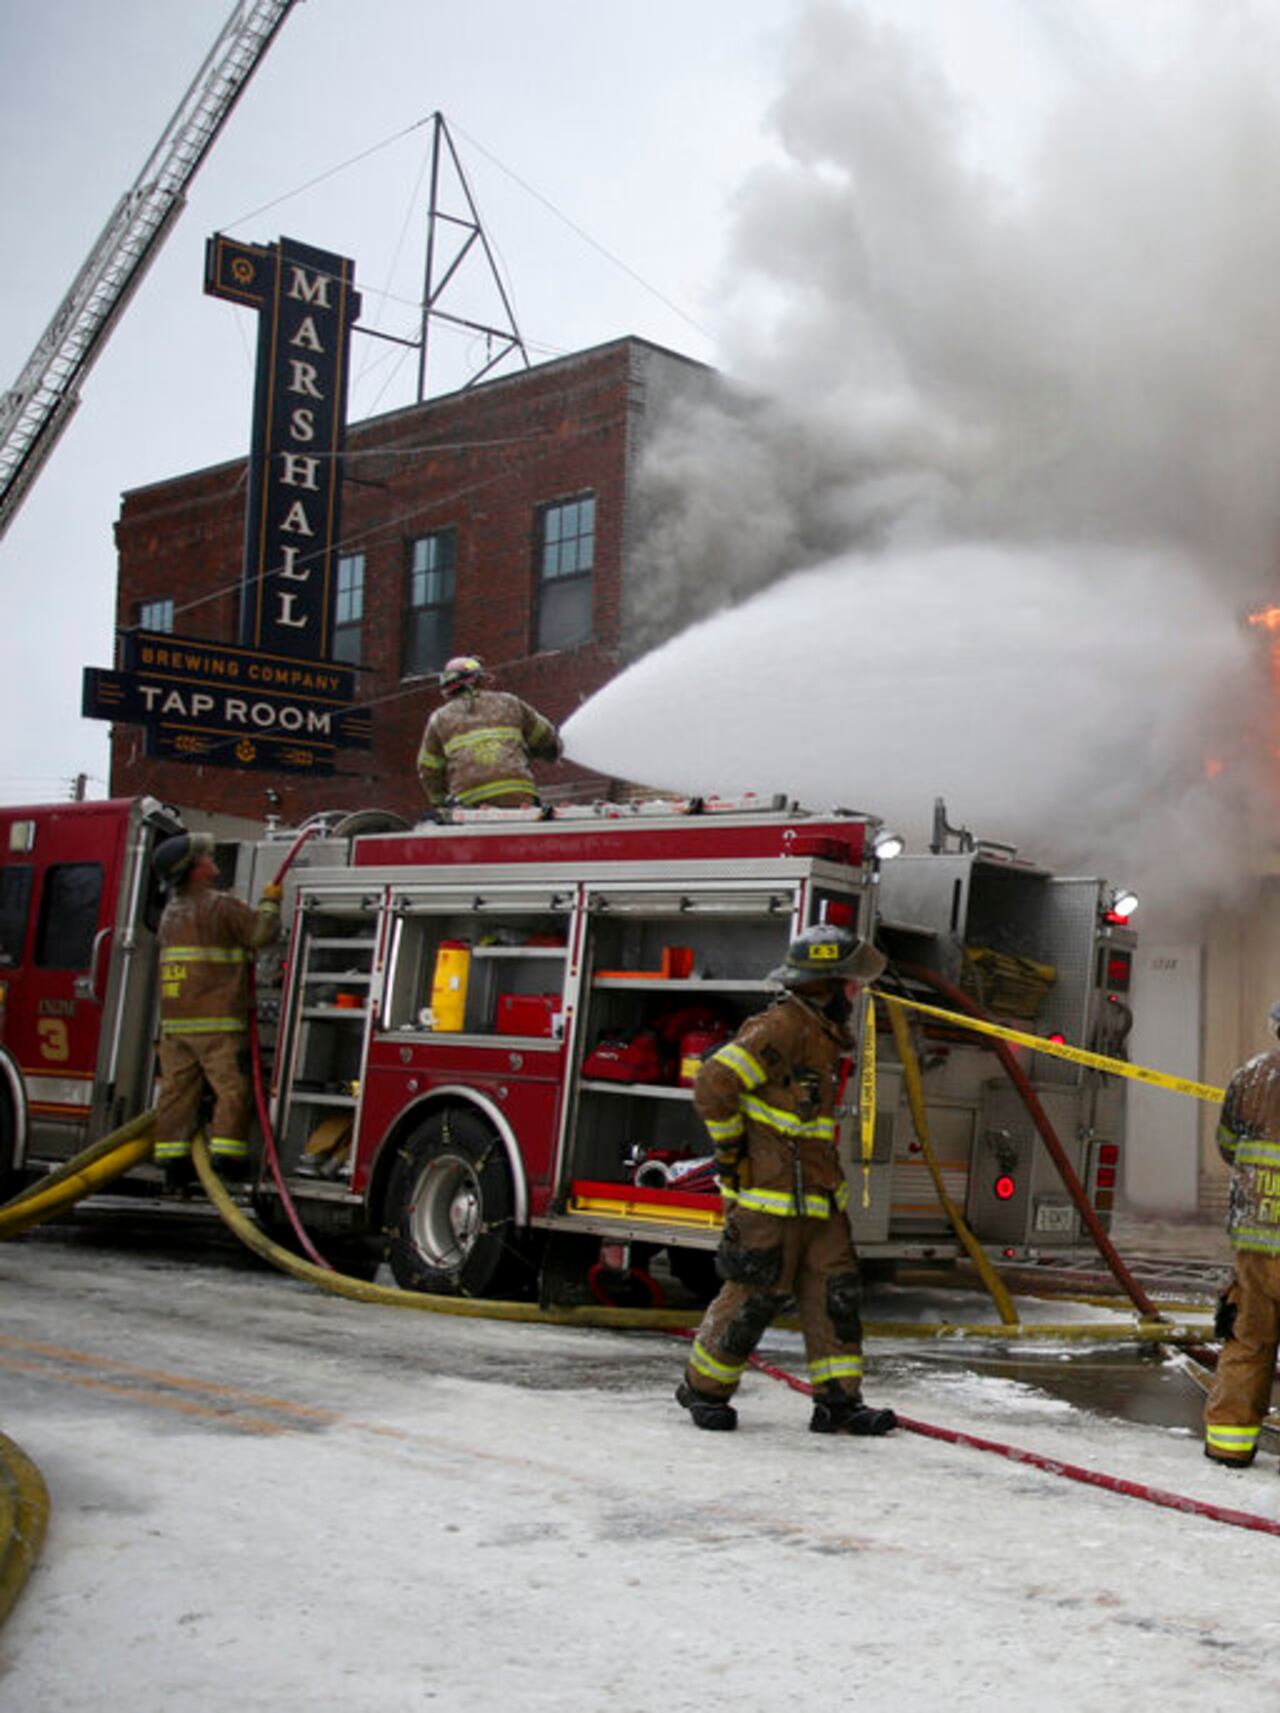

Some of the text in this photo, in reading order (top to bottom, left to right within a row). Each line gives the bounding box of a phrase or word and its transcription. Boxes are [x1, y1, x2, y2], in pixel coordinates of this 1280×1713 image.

[276, 266, 332, 629] MARSHALL
[141, 648, 341, 692] BREWING COMPANY
[139, 686, 332, 735] TAP ROOM
[37, 1018, 69, 1061] 3
